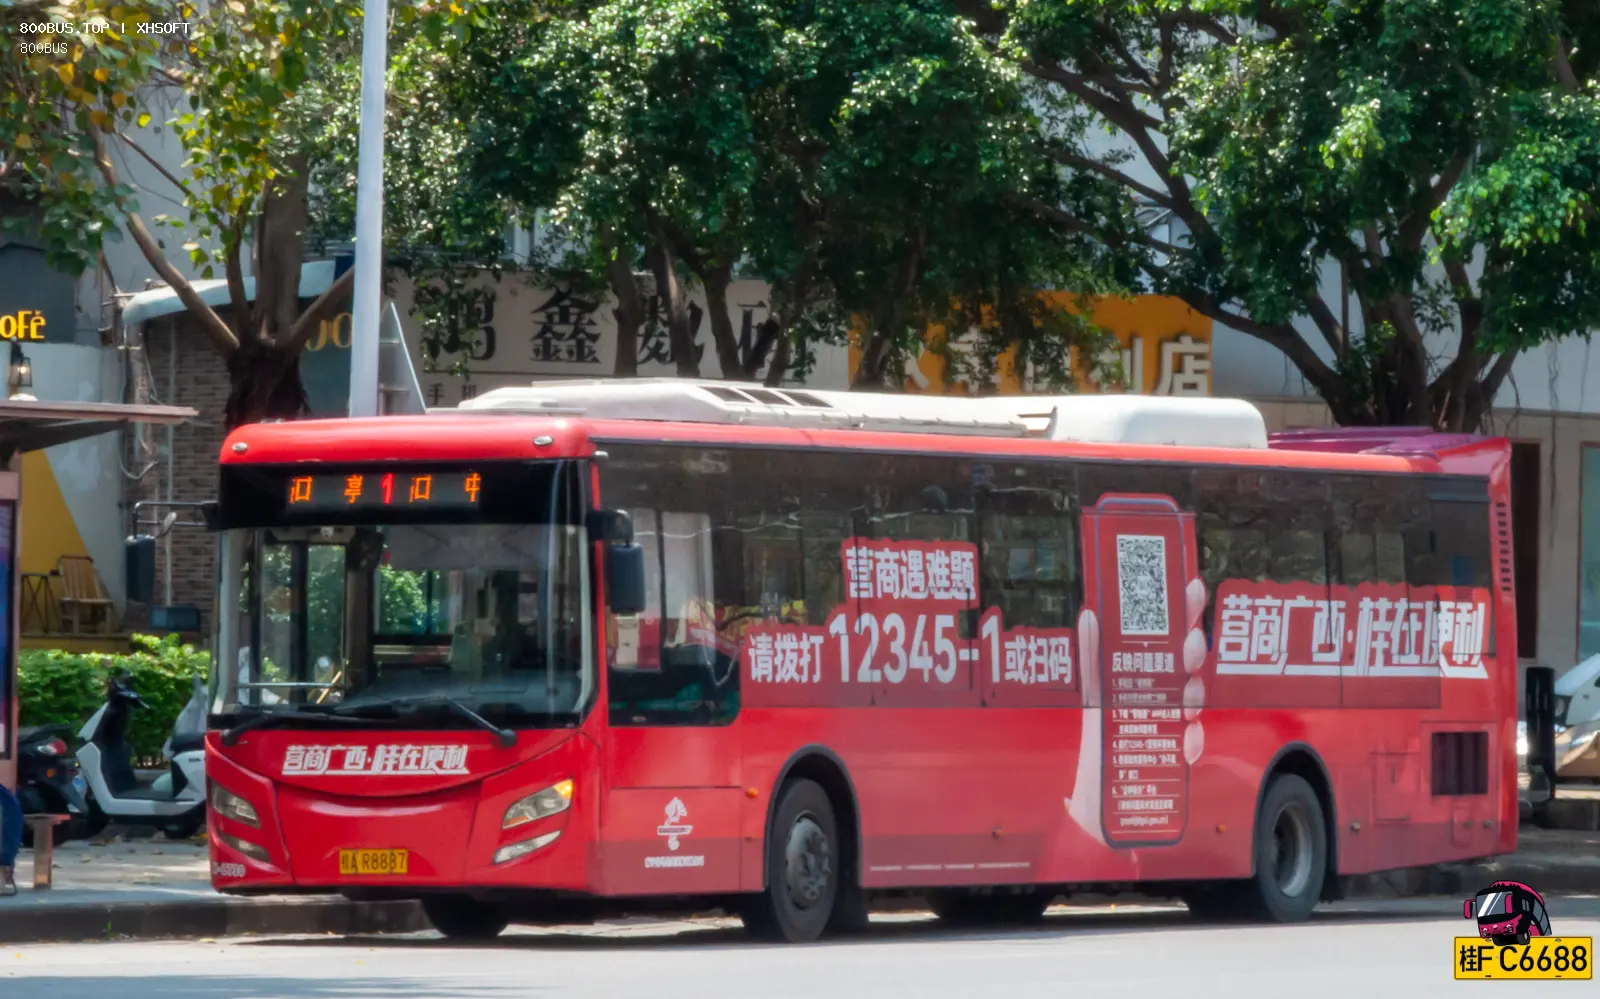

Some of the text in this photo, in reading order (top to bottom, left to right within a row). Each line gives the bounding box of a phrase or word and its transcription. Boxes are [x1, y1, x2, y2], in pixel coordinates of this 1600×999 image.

[846, 545, 977, 600] 营商遇难题
